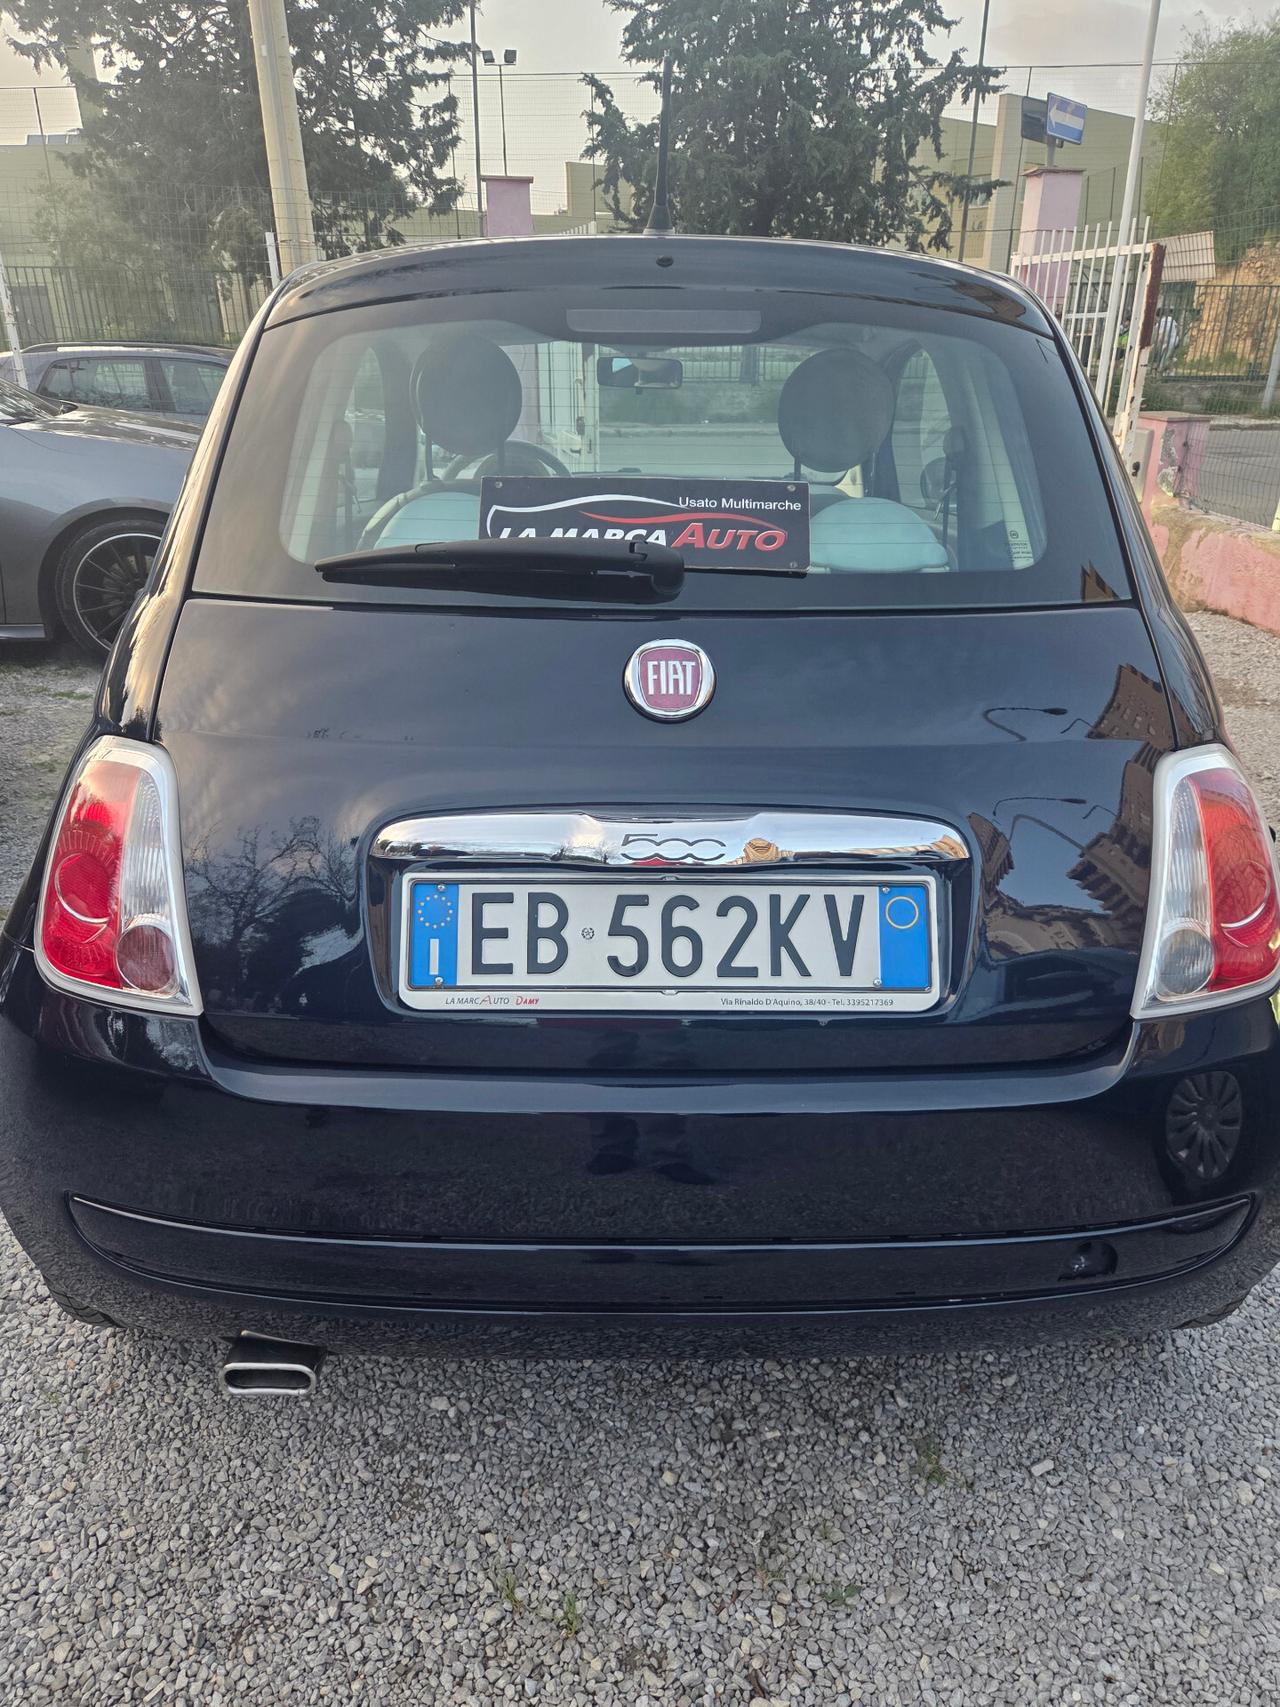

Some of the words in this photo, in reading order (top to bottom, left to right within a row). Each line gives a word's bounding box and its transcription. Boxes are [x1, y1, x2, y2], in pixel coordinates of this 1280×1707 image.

[679, 496, 717, 508] Usato
[721, 498, 801, 511] Multimarche
[647, 660, 696, 695] FIAT
[620, 833, 726, 861] 500
[471, 892, 569, 975] EB
[606, 894, 865, 978] 562KV
[445, 997, 455, 1005] LA
[720, 998, 733, 1006] Via
[735, 998, 764, 1006] Rinaldo
[805, 998, 826, 1006] 38/40
[847, 998, 894, 1007] 3395217369
